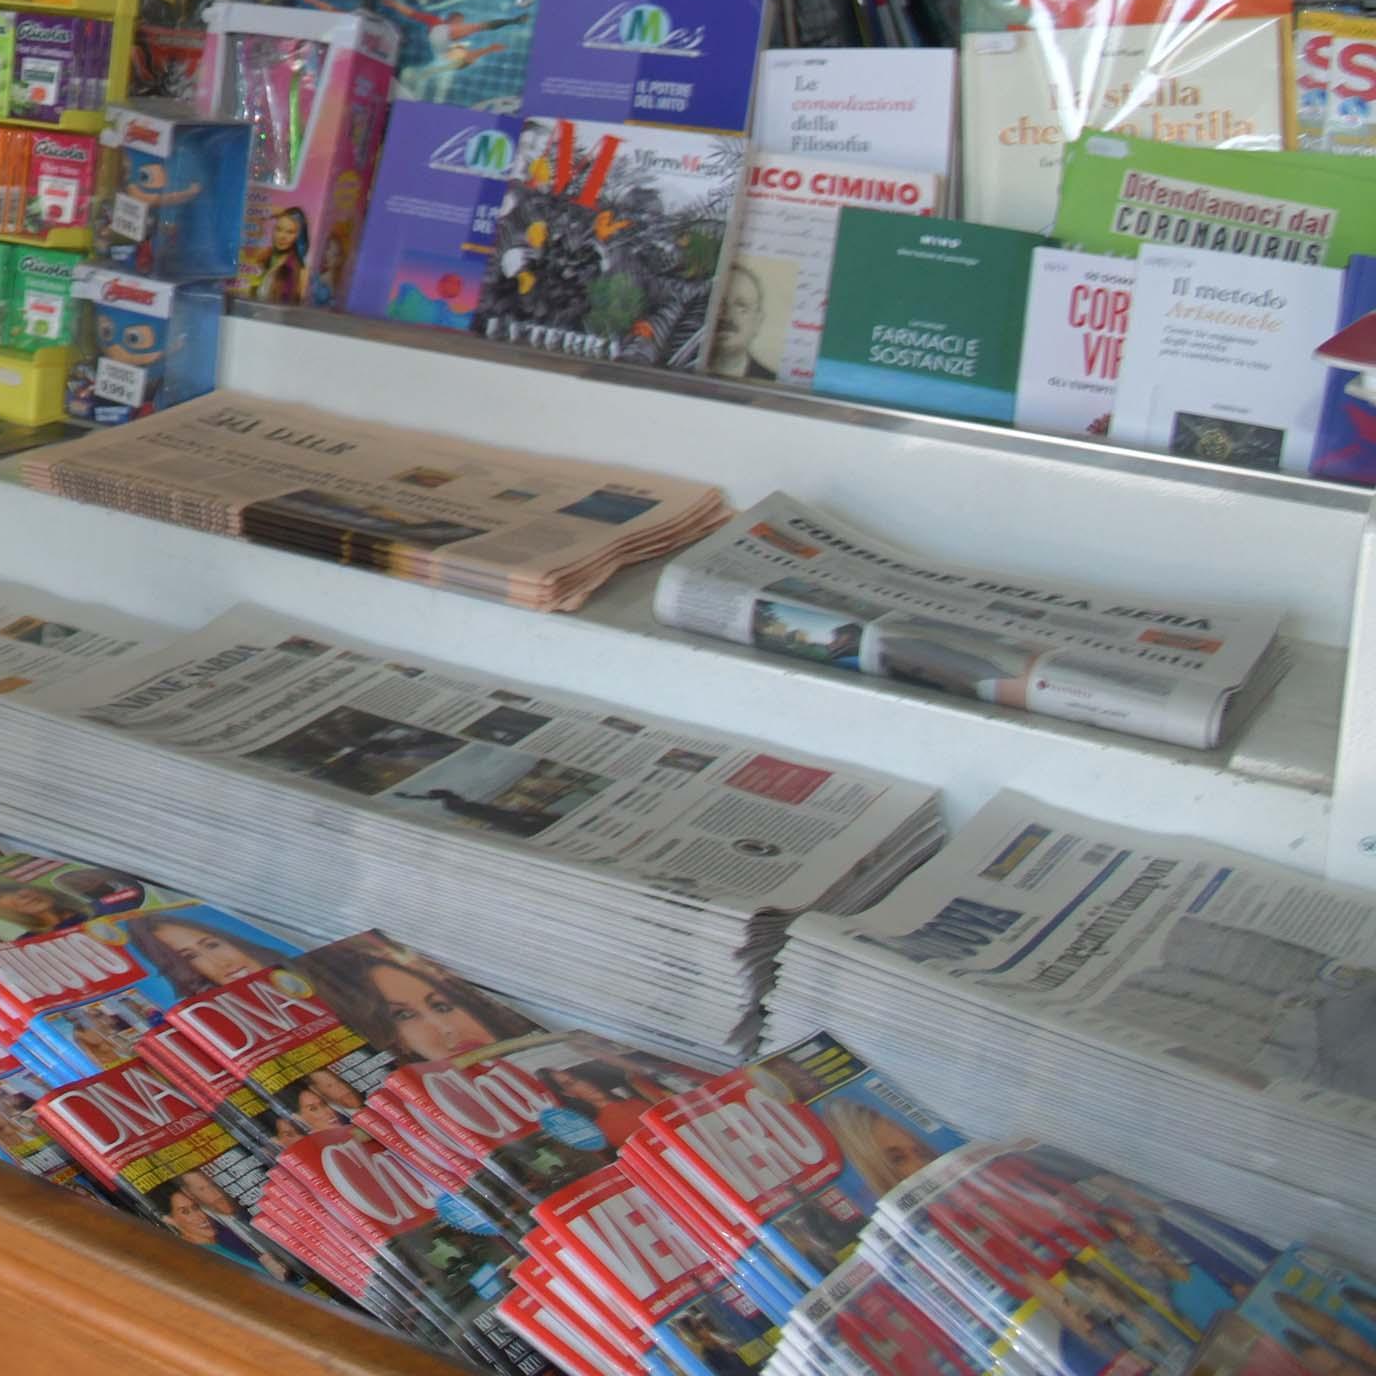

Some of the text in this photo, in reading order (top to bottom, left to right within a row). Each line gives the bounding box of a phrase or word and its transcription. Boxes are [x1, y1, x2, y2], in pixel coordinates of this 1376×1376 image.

[1103, 76, 1200, 108] stlla
[791, 116, 839, 133] della
[791, 136, 871, 154] Filosofia
[998, 115, 1060, 146] che
[810, 173, 920, 204] CIMINO
[1123, 171, 1330, 238] Difendiamoci dal
[1115, 205, 1321, 266] CORONAVIRUS
[1193, 285, 1288, 311] metodo
[868, 344, 978, 378] SOSTANZE
[872, 324, 964, 355] FARMACI
[787, 517, 1211, 632] CORRIERE DELLA SERA
[179, 981, 328, 1061] DIVA
[48, 1070, 195, 1155] DIVA
[420, 1057, 551, 1142] Chi
[675, 1086, 825, 1204] VERO
[329, 1144, 440, 1228] Chi
